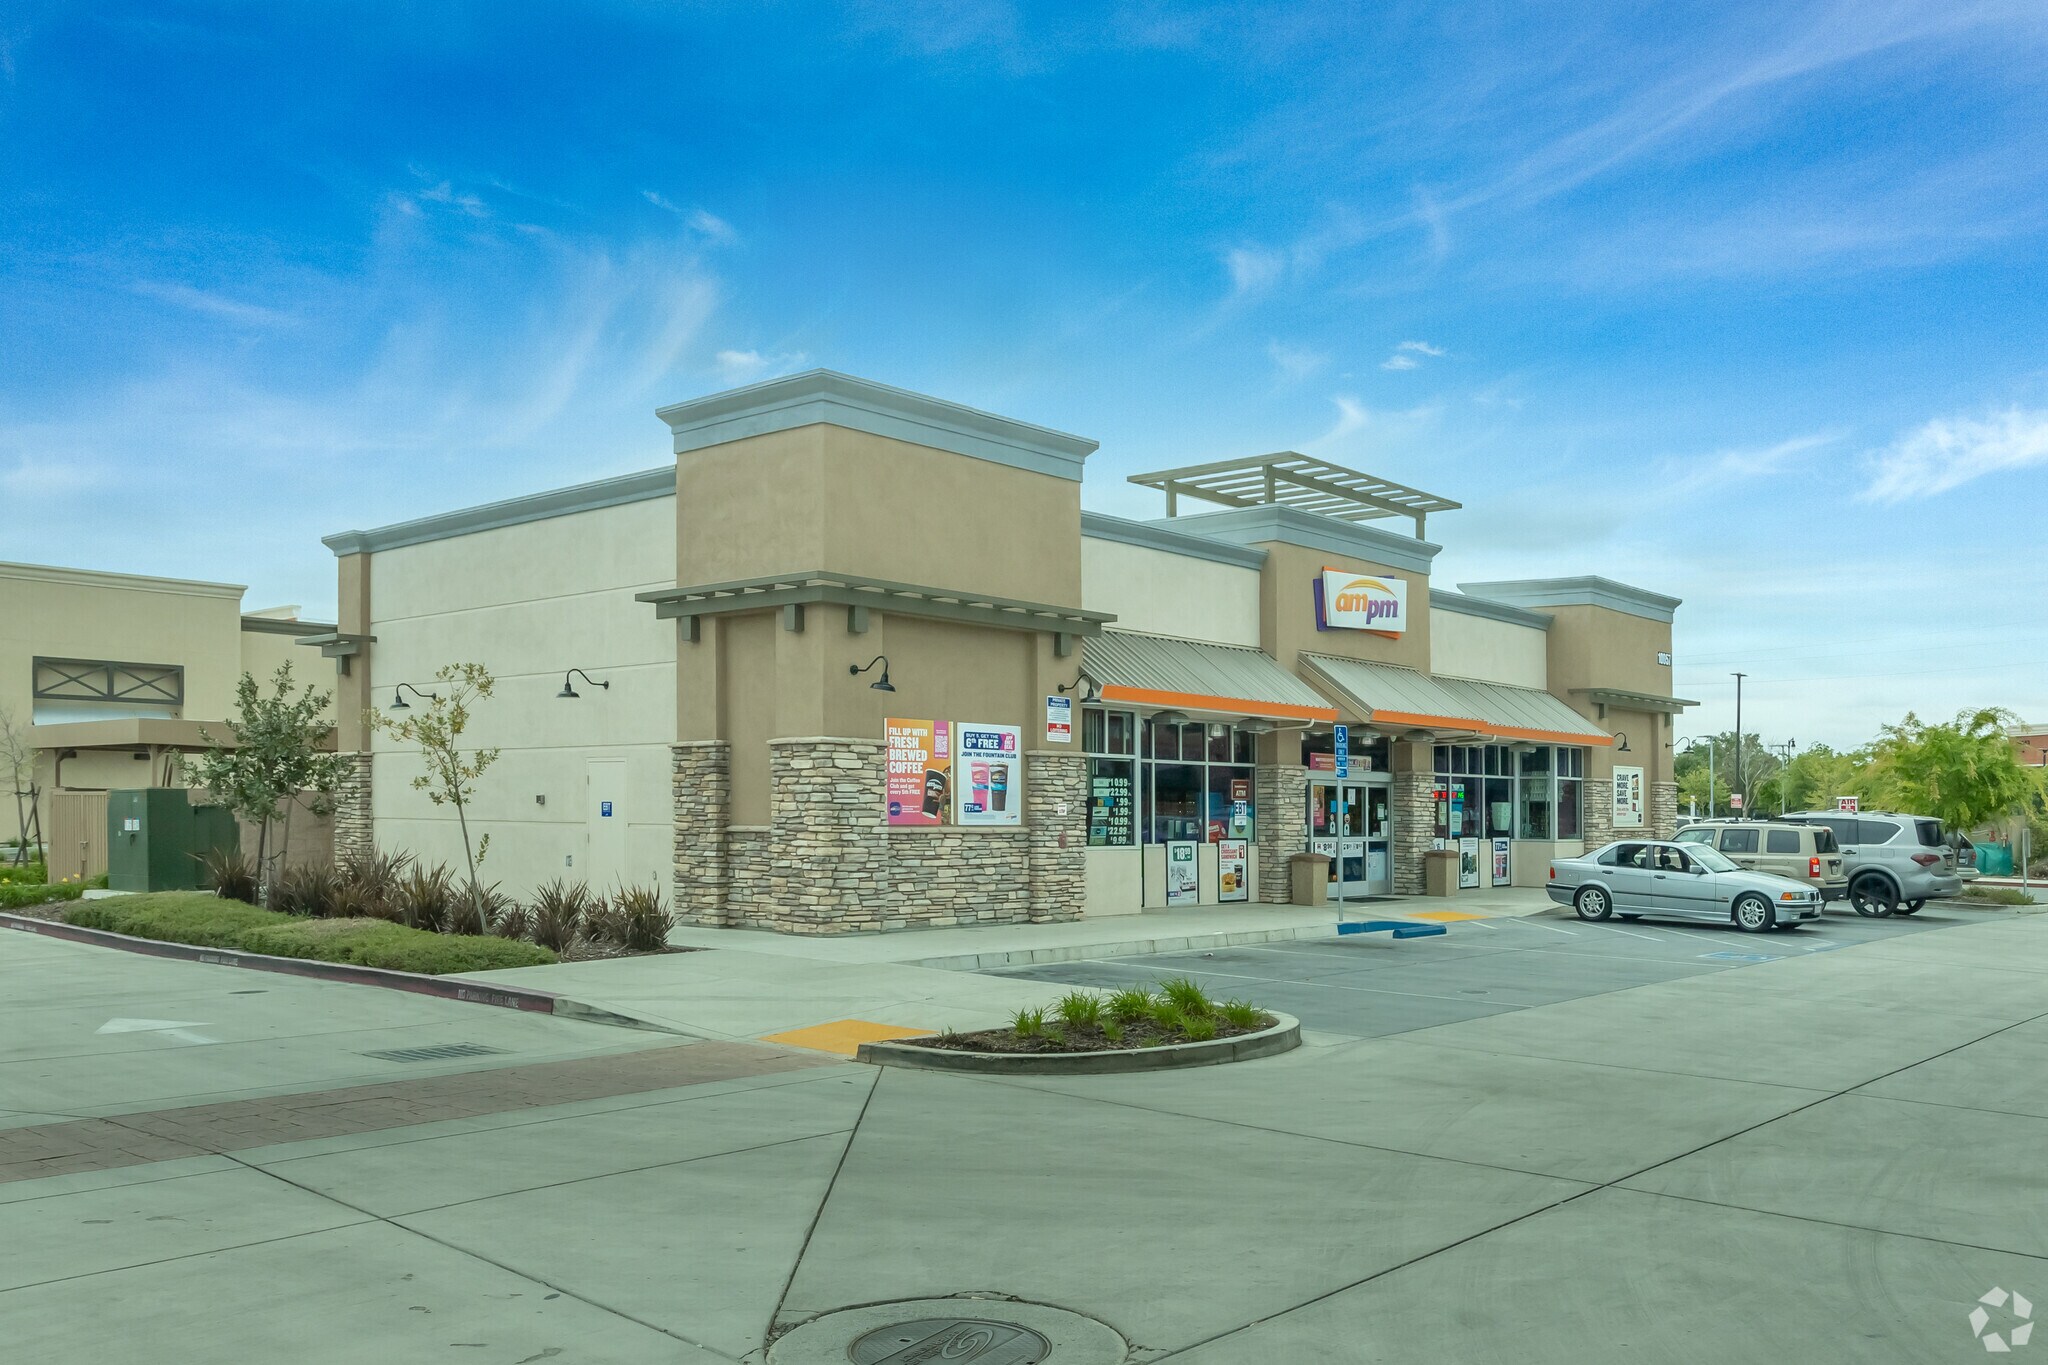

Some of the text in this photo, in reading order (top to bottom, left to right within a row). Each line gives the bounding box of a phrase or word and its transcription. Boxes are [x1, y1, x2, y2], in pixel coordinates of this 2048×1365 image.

[1336, 593, 1399, 625] ampm
[889, 727, 902, 736] FILL
[902, 728, 911, 736] UP
[912, 728, 928, 737] WITH
[889, 736, 920, 749] FRESH
[978, 739, 999, 749] FREE
[889, 749, 928, 762] BREWED
[889, 761, 924, 774] COFFEE
[1617, 774, 1629, 782] CRAVE
[1235, 801, 1247, 814] EBT
[458, 989, 519, 1008] NO PARKING FIRE LANE
